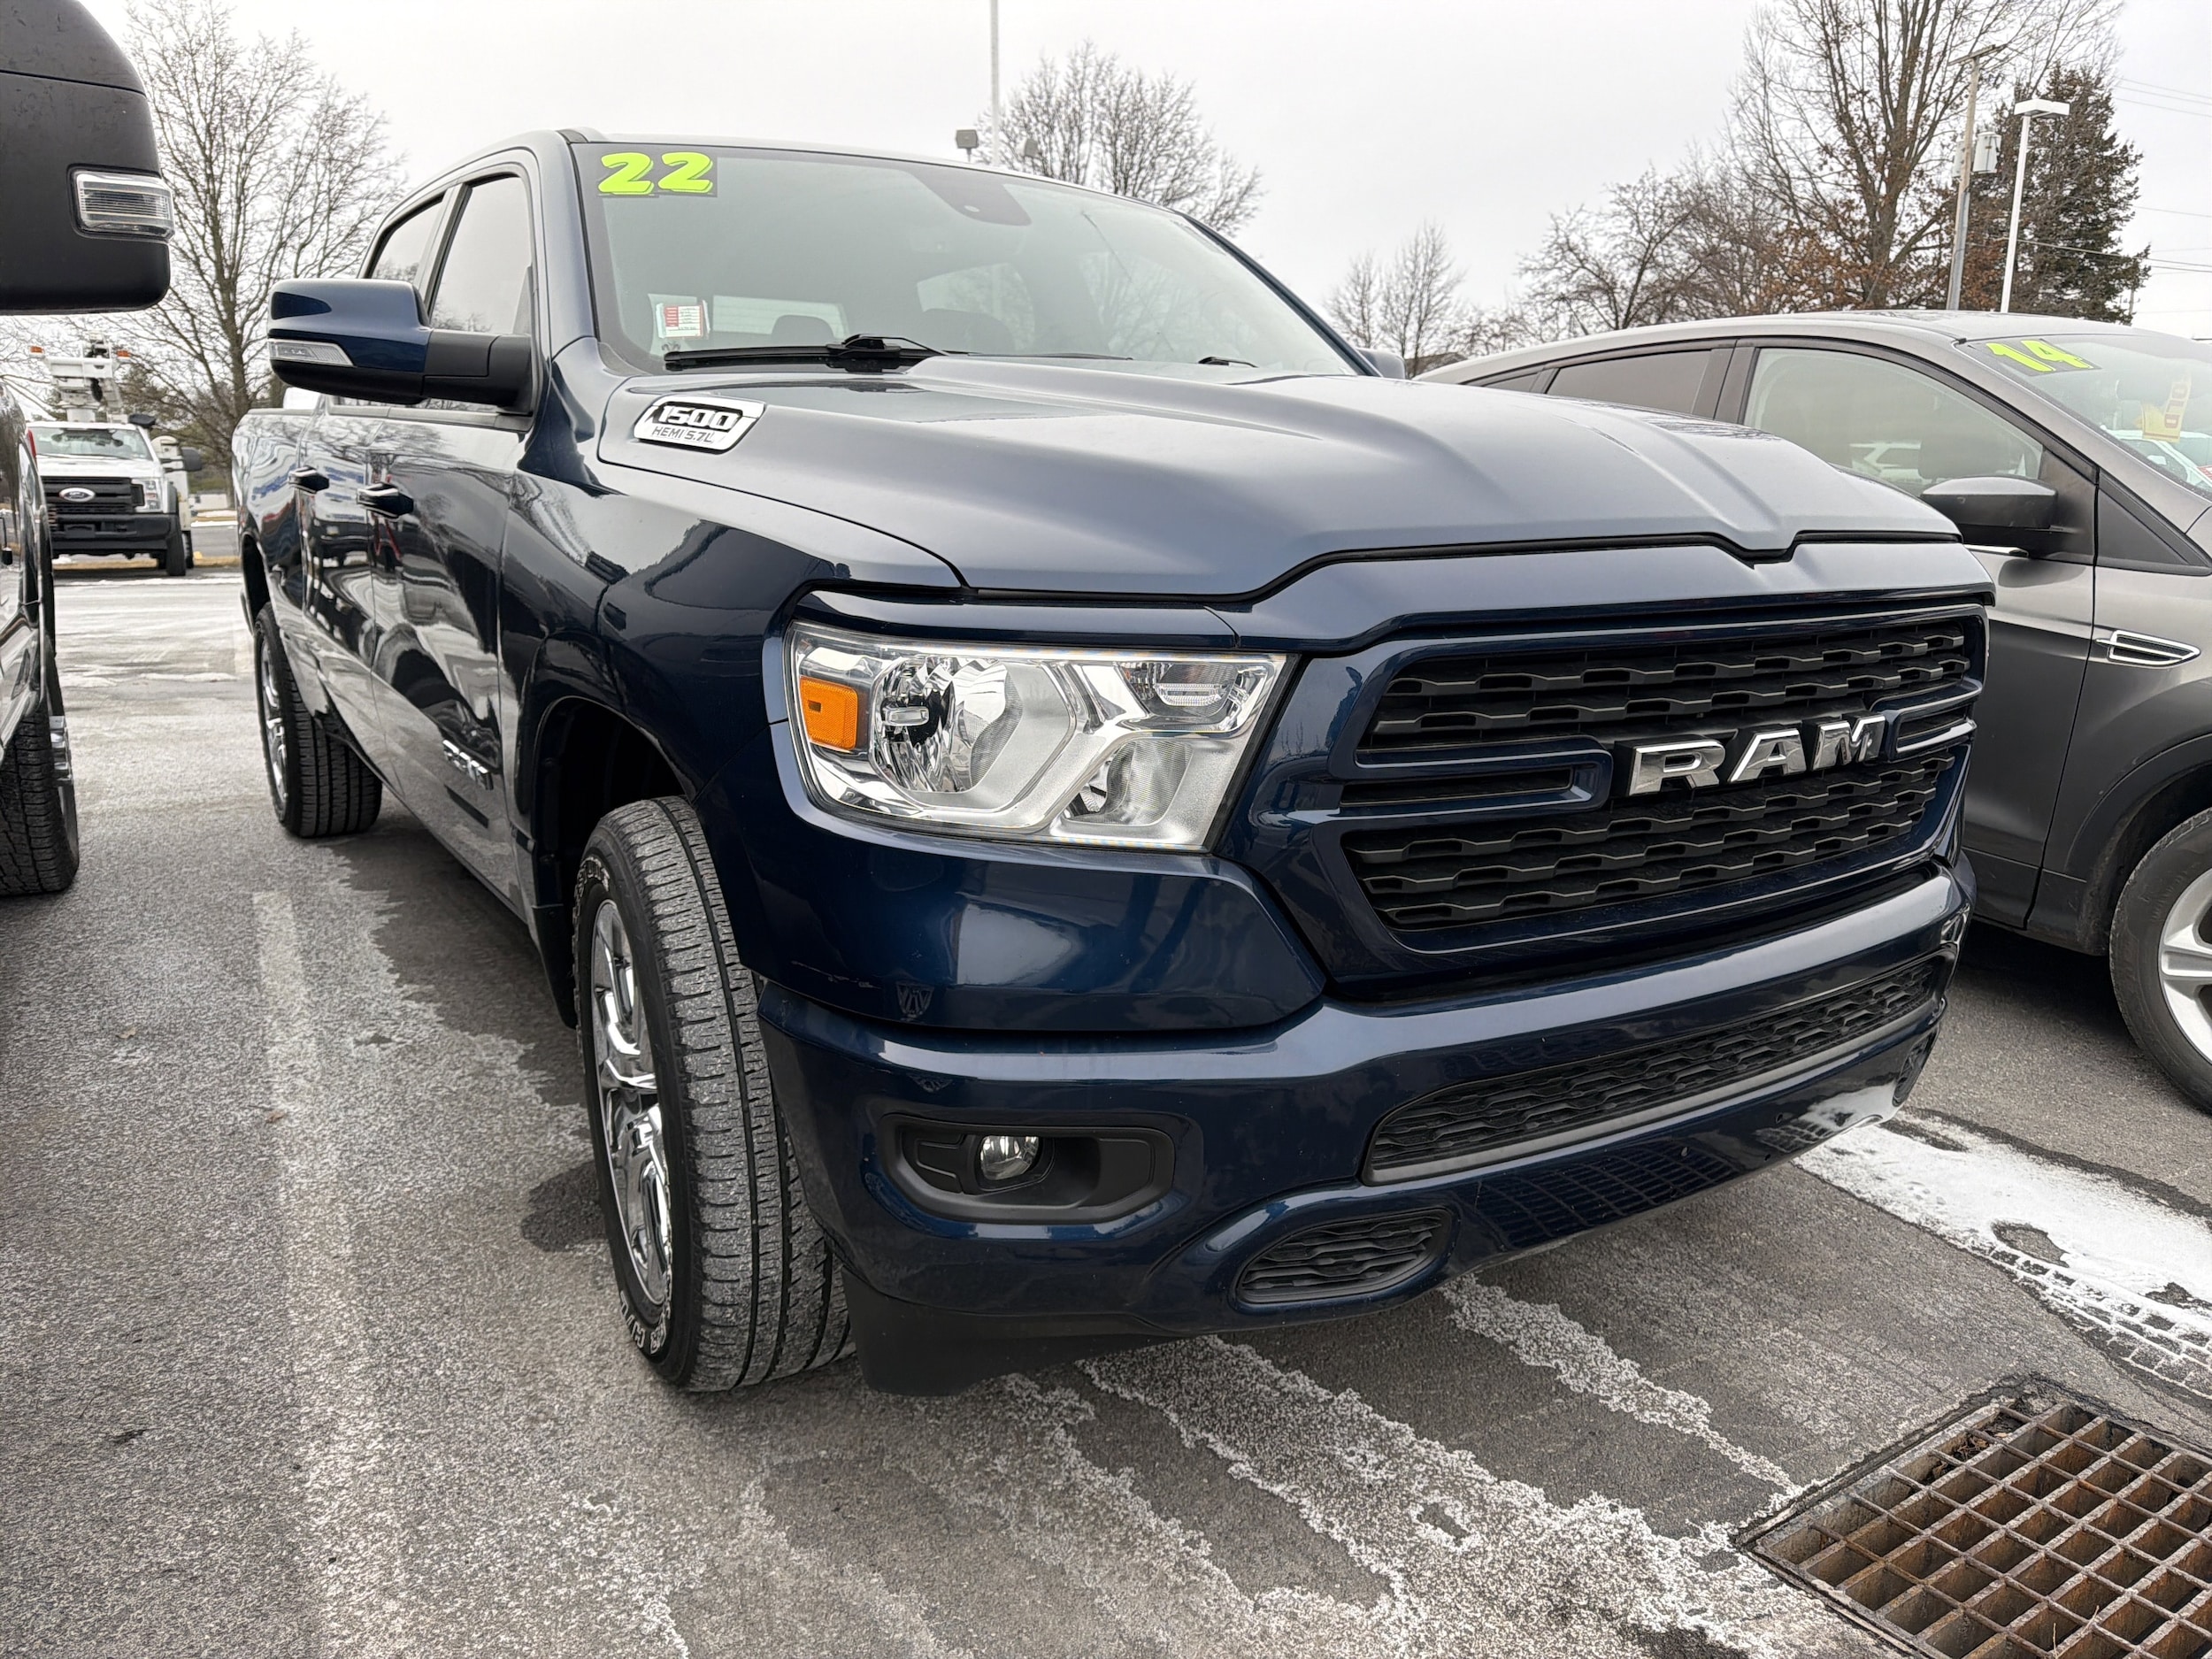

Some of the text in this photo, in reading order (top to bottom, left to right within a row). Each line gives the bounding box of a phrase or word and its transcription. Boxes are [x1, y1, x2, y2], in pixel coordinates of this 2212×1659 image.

[598, 151, 713, 195] 22
[1986, 340, 2093, 372] 14
[658, 404, 740, 431] 1500
[652, 426, 713, 442] HEMI 5.7L
[1628, 715, 1886, 796] RAM
